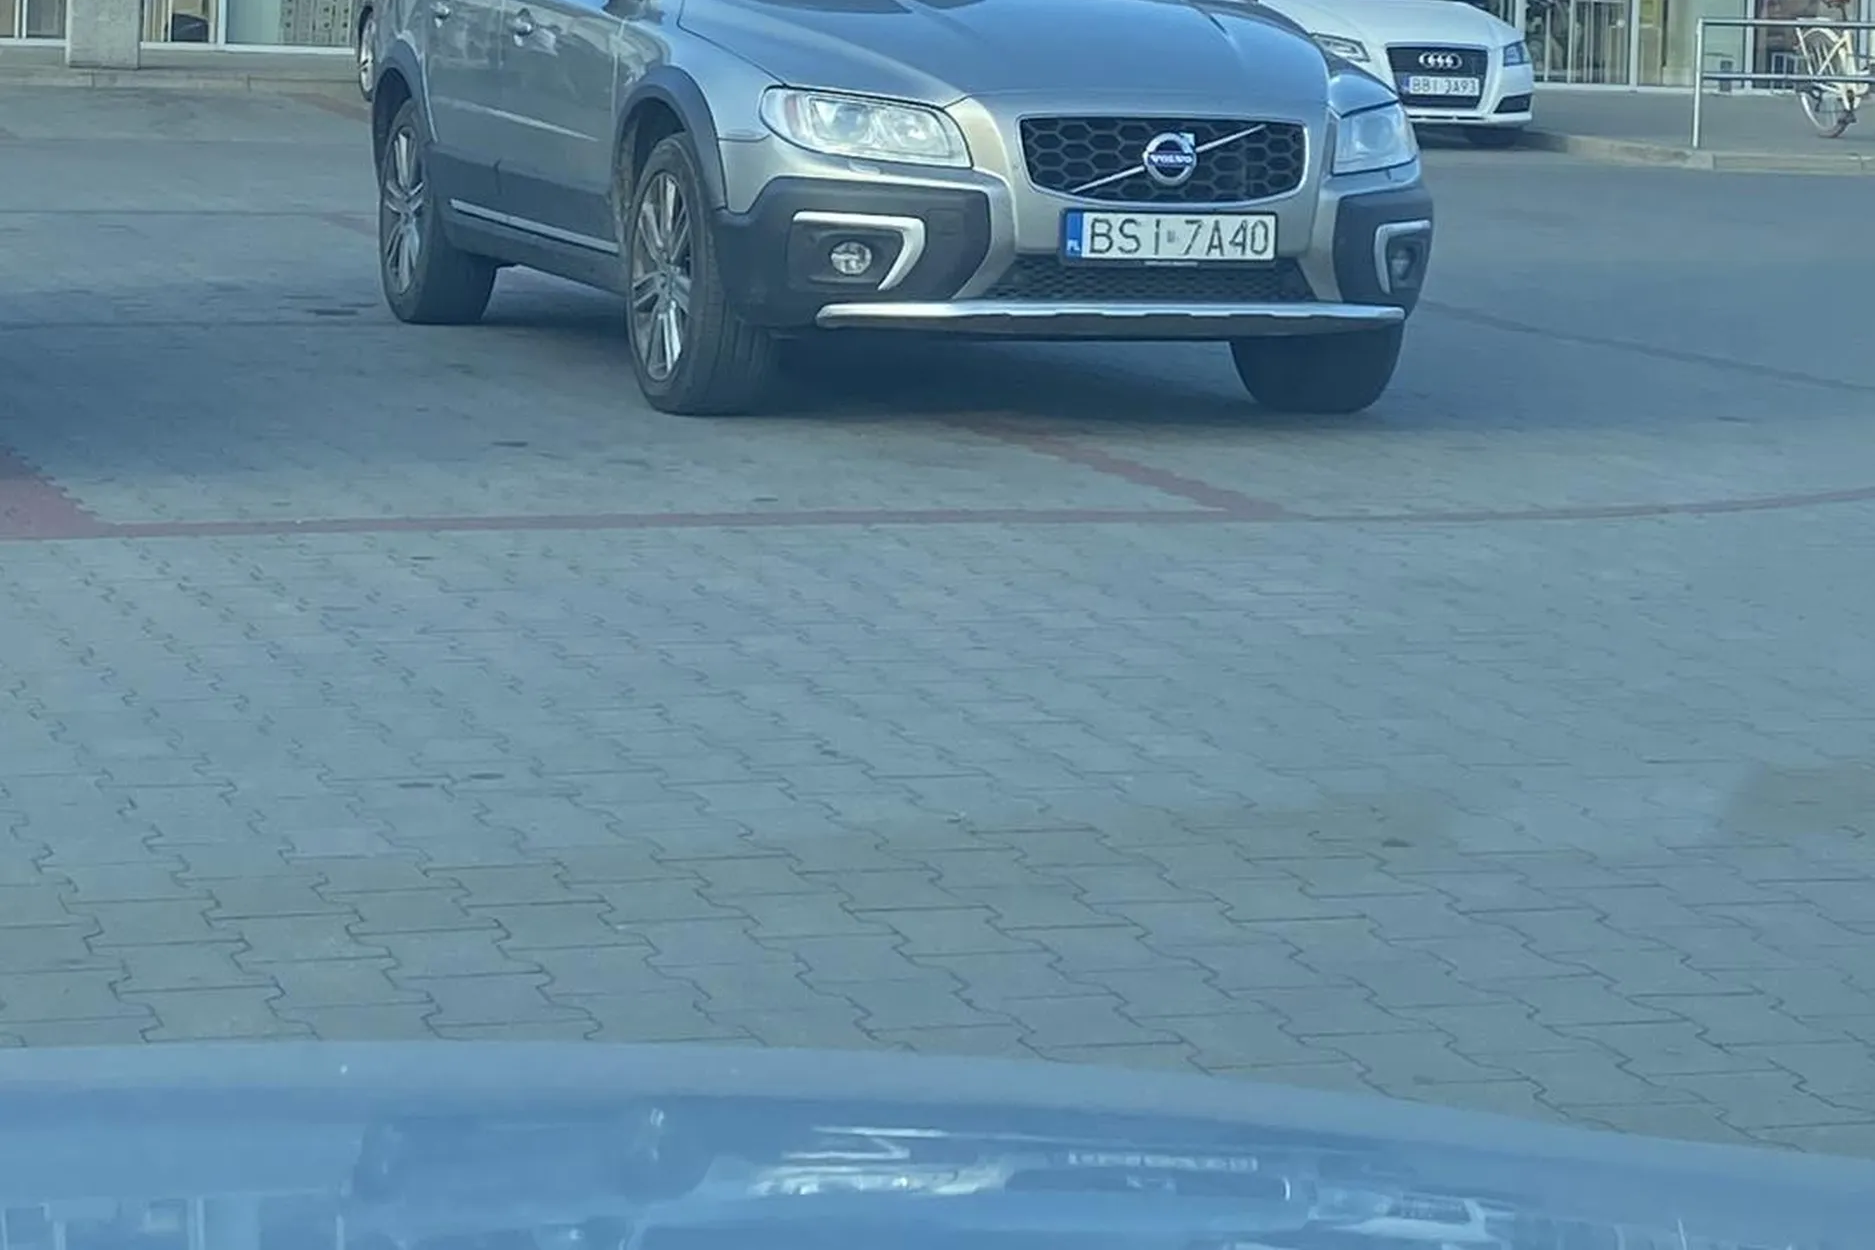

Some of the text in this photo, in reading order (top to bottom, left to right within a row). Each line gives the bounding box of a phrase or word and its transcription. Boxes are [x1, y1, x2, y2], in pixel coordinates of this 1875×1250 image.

[1150, 154, 1194, 165] VOLVO
[1090, 217, 1270, 257] BSI 7A40
